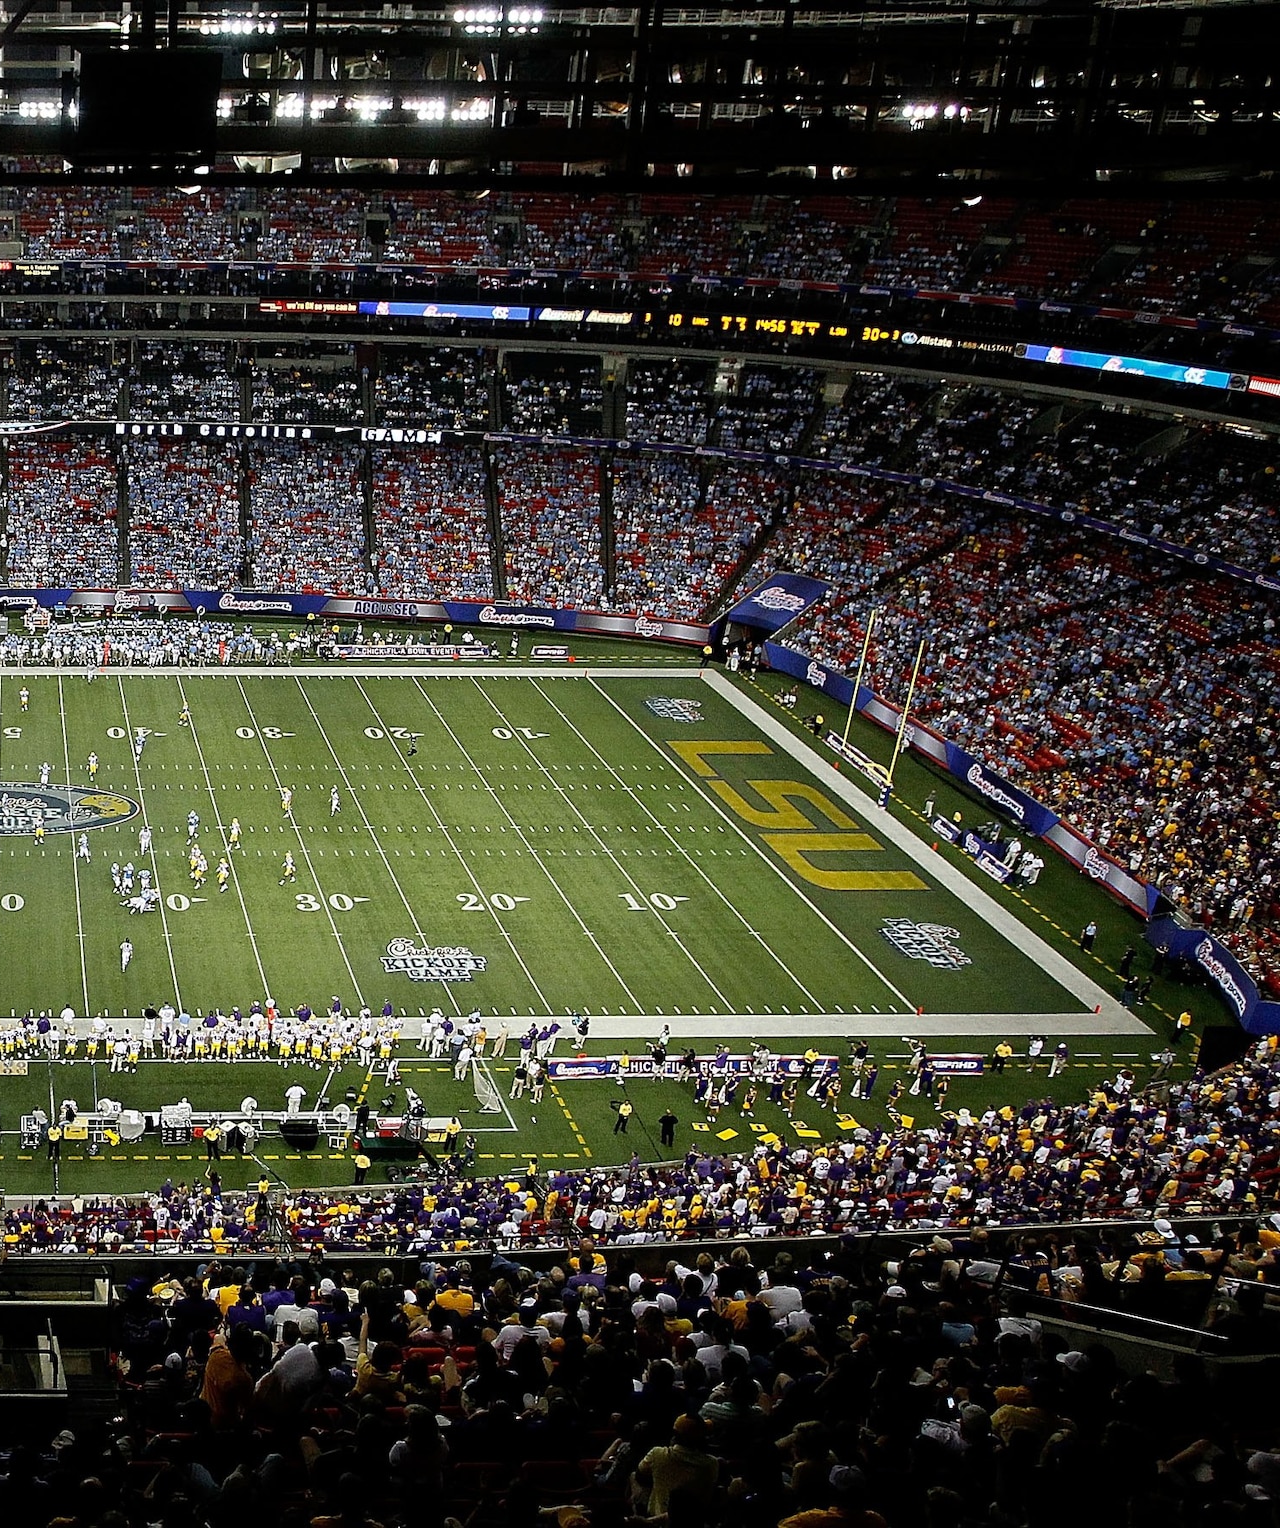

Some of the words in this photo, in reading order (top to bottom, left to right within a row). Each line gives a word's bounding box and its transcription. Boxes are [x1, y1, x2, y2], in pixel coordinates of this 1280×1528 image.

[917, 335, 952, 348] Allstate
[354, 601, 379, 614] ACC
[236, 727, 285, 740] 30
[363, 727, 412, 740] 20
[492, 727, 538, 740] 10
[667, 740, 931, 891] LSU
[295, 892, 356, 912] 30
[455, 892, 518, 911] 20
[619, 892, 678, 911] 10
[381, 957, 488, 971] KICKOFF
[410, 968, 470, 977] GAME
[819, 1162, 828, 1171] 32
